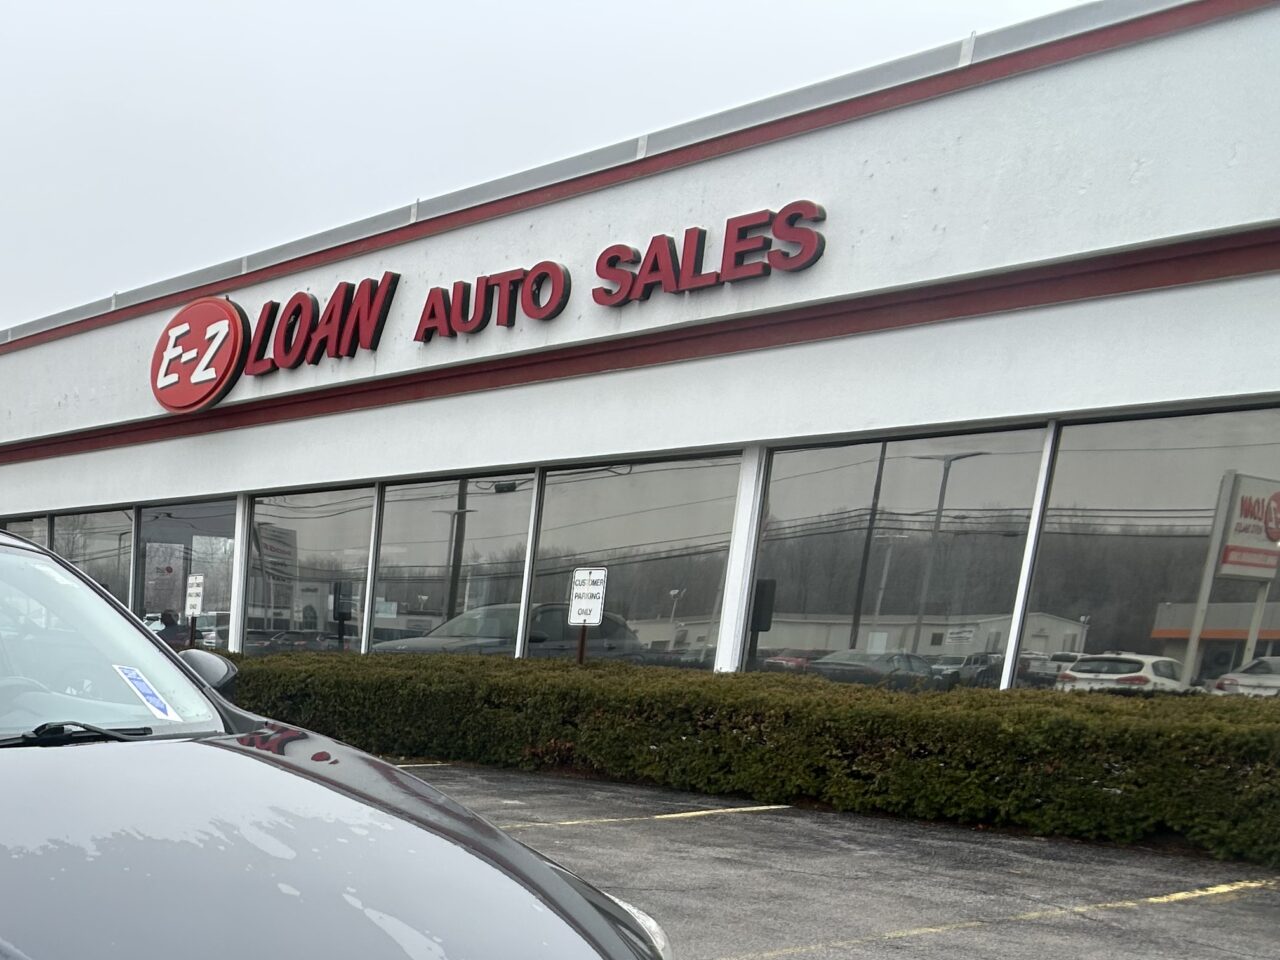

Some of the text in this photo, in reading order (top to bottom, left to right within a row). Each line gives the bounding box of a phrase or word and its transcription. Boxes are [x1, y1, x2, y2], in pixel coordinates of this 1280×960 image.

[156, 199, 827, 389] E-Z LOAN AUTO SALES
